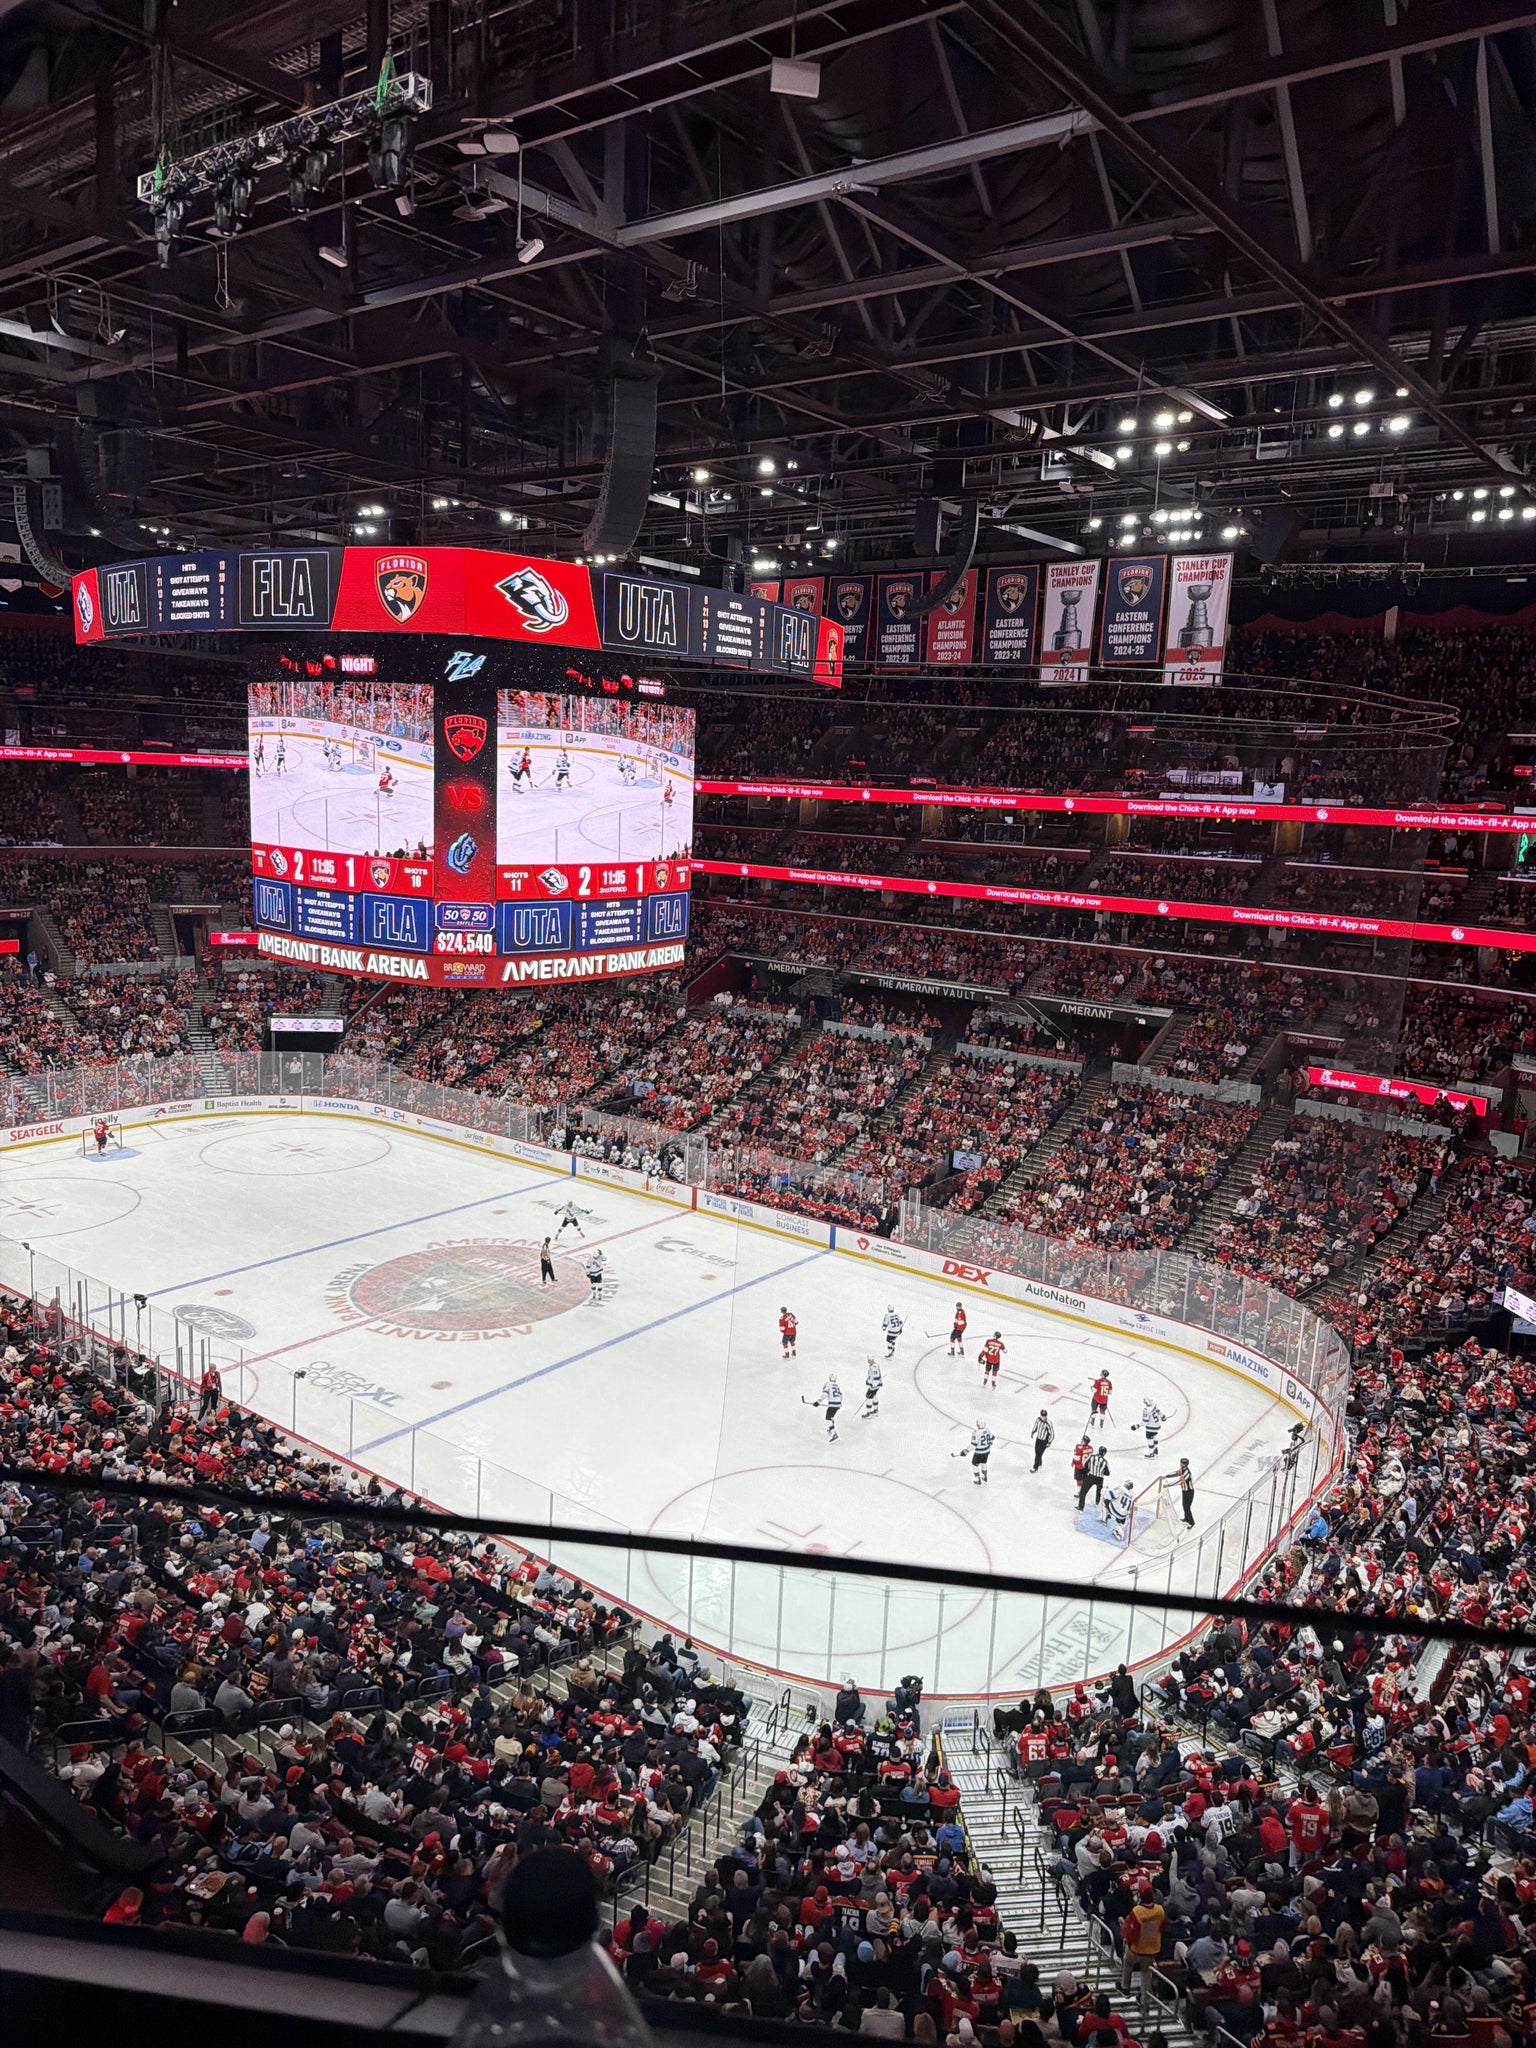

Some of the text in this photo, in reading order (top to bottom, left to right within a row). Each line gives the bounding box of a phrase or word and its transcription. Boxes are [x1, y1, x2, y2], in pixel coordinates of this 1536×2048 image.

[181, 563, 197, 572] HITS
[381, 559, 423, 572] FLORIDA
[1050, 564, 1096, 578] STANLEY CUP
[1176, 558, 1228, 572] STANLEY CUP
[170, 575, 210, 585] SHOT ATTEMPTS
[1051, 575, 1093, 588] CHAMPIONS
[1177, 571, 1225, 583] CHAMPIONS
[172, 587, 208, 596] GIVEAWAYS
[252, 558, 315, 617] FLA
[107, 569, 140, 625] UTA
[171, 599, 209, 608] TAKEAWAYS
[729, 601, 743, 611] HITS
[170, 611, 210, 620] BLOCKED SHOTS
[618, 582, 677, 646] UTA
[717, 611, 753, 624] SHOT ATTEMPTS
[1115, 611, 1149, 622] EASTERN
[718, 622, 751, 635] GIVEAWAYS
[886, 624, 912, 633] EASTERN
[937, 619, 966, 630] ATLANTIC
[995, 618, 1024, 628] EASTERN
[1108, 622, 1154, 633] CONFERENCE
[717, 634, 752, 646] TAKEAWAYS
[880, 634, 916, 644] CONFERENCE
[937, 630, 964, 640] DIVISION
[989, 628, 1029, 639] CONFERENCE
[1108, 634, 1152, 645] CHAMPIONS
[780, 613, 810, 668] FLA
[932, 640, 968, 650] CHAMPIONS
[989, 639, 1028, 650] CHAMPIONS
[716, 645, 738, 655] BLOCKED
[881, 643, 915, 653] CHAMPIONS
[1113, 645, 1145, 656] 2024-25
[936, 651, 962, 661] 2023-24
[993, 650, 1021, 660] 2023-24
[341, 658, 375, 672] NIGHT
[444, 651, 487, 683] FLA
[1053, 669, 1075, 681] 2024
[43, 751, 58, 760] App
[58, 751, 73, 759] now
[180, 756, 225, 764] Download the
[737, 784, 763, 793] Download
[762, 785, 772, 793] the
[800, 788, 812, 796] App
[446, 786, 483, 808] VS
[913, 792, 943, 802] Download
[943, 793, 954, 802] the
[989, 796, 1001, 806] App
[1127, 801, 1164, 812] Download
[1164, 803, 1178, 812] the
[1221, 806, 1238, 816] App
[1238, 807, 1256, 815] now
[1395, 813, 1440, 824] Download
[1440, 815, 1456, 825] the
[1511, 819, 1530, 830] App
[293, 851, 304, 881] 2
[312, 858, 335, 875] 11:05
[345, 857, 355, 888] 1
[403, 867, 428, 875] SHOTS
[410, 875, 422, 888] 16
[578, 866, 591, 896] 2
[603, 869, 626, 885] 11:05
[636, 864, 644, 893] 1
[789, 871, 816, 880] Download
[816, 872, 826, 881] the
[858, 876, 870, 885] App
[510, 879, 522, 892] 11
[317, 891, 331, 899] HITS
[986, 888, 1019, 899] Download
[1019, 891, 1031, 899] the
[1070, 896, 1085, 906] App
[1086, 898, 1102, 906] now
[259, 884, 286, 924] UTA
[308, 908, 341, 919] GIVEAWAYS
[444, 909, 487, 922] 50 50
[590, 910, 606, 918] SHOT
[655, 899, 682, 935] FLA
[1233, 910, 1275, 921] Download
[1275, 913, 1290, 923] the
[1340, 918, 1359, 930] App
[1360, 922, 1379, 930] now
[307, 916, 342, 928] TAKEAWAYS
[373, 901, 418, 943] FLA
[513, 908, 562, 946] UTA
[595, 918, 630, 927] GIVEAWAYS
[594, 927, 631, 936] TAKEAWAYS
[437, 932, 493, 954] $24,540
[589, 936, 616, 945] BLOCKED
[258, 932, 430, 980] AMERANT BANK ARENA
[443, 962, 486, 973] BROWARD
[501, 944, 685, 982] AMERANT BANK ARENA
[767, 962, 807, 976] AMERANT
[878, 978, 976, 1000] THE AMERANT VAULT
[1059, 1004, 1113, 1020] AMERANT
[1517, 1072, 1533, 1083] 104
[168, 1103, 193, 1111] ACTION
[216, 1100, 239, 1109] Baptist
[240, 1099, 263, 1108] Health
[323, 1101, 361, 1112] HONDA
[9, 1122, 64, 1142] SEATGEEK
[656, 1182, 677, 1196] Coca-Cola
[776, 1212, 810, 1226] COMCAST
[776, 1220, 810, 1236] BUSINESS
[426, 1237, 570, 1249] AMERANT
[681, 1247, 739, 1267] CELSIUS
[941, 1260, 993, 1286] DEX
[323, 1262, 375, 1323] BANK ARENA
[1024, 1283, 1086, 1310] AutoNation
[182, 1311, 245, 1337] Ford
[890, 1318, 900, 1328] 53
[1118, 1317, 1135, 1328] Disney
[365, 1325, 533, 1342] AMERANT
[988, 1345, 1000, 1356] 27
[1226, 1349, 1270, 1379] AMAZING
[309, 1360, 377, 1393] OMEGA
[1099, 1385, 1109, 1396] 15
[1296, 1391, 1311, 1409] App
[1120, 1495, 1132, 1511] 41
[1016, 1637, 1074, 1681] Health
[1028, 1744, 1046, 1762] 63
[1301, 1820, 1318, 1838] 19
